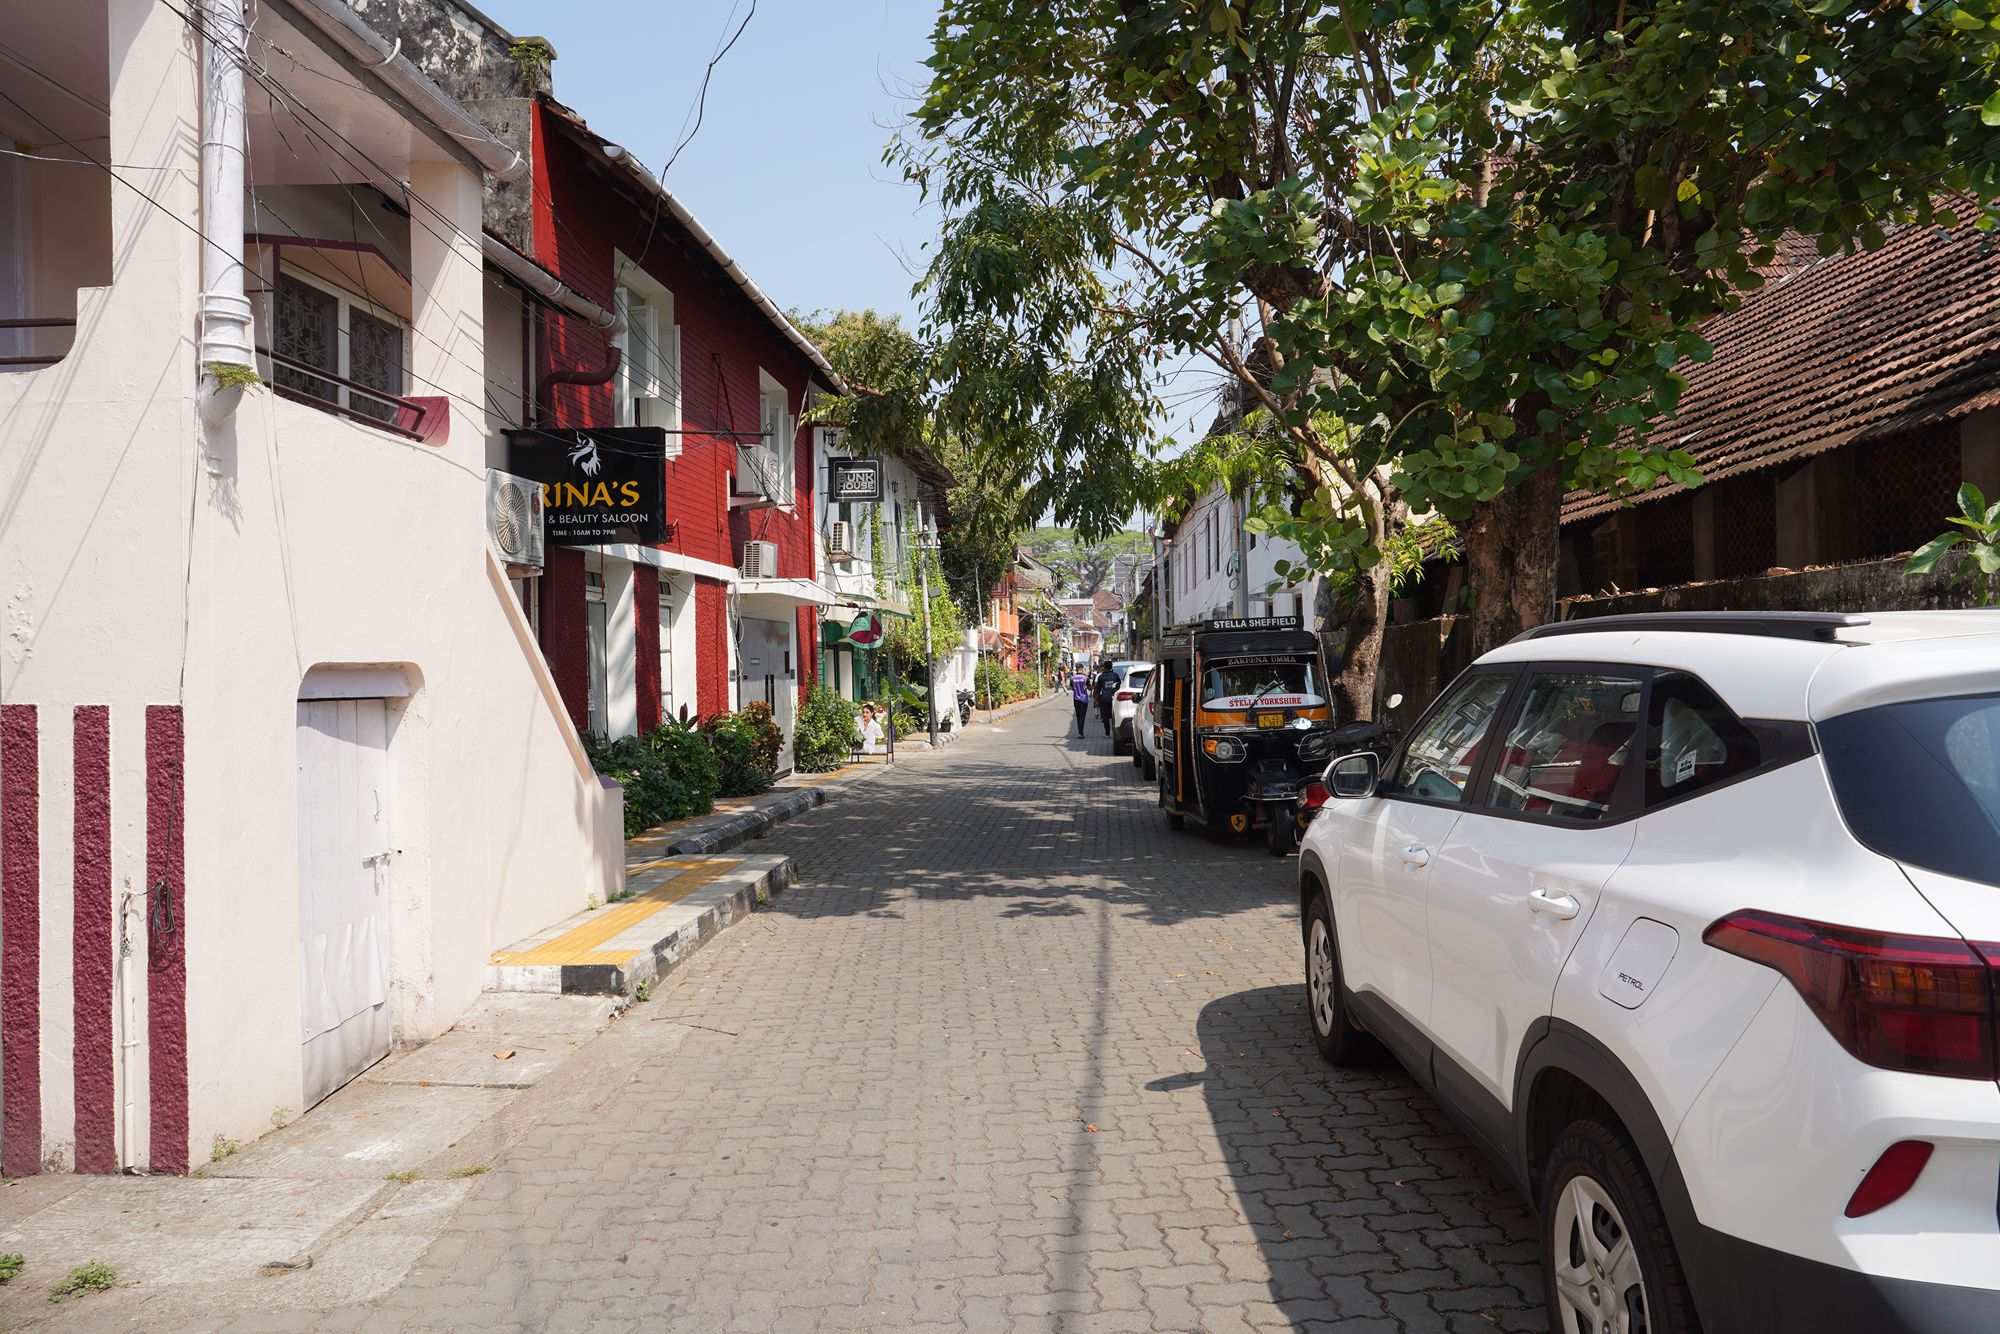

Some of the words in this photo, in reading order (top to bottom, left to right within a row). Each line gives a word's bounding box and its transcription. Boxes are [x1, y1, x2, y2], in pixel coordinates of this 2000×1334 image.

[838, 472, 874, 482] BUNK
[838, 482, 874, 490] HOUSE
[548, 515, 556, 524] &
[560, 514, 598, 524] BEAUTY
[602, 513, 648, 523] SALOON
[1214, 619, 1247, 629] STELLA
[1249, 618, 1297, 627] SHEFFIELD
[1229, 698, 1258, 708] STELLA
[1260, 697, 1302, 706] YORKSHIRE
[1618, 972, 1644, 991] PETROL
